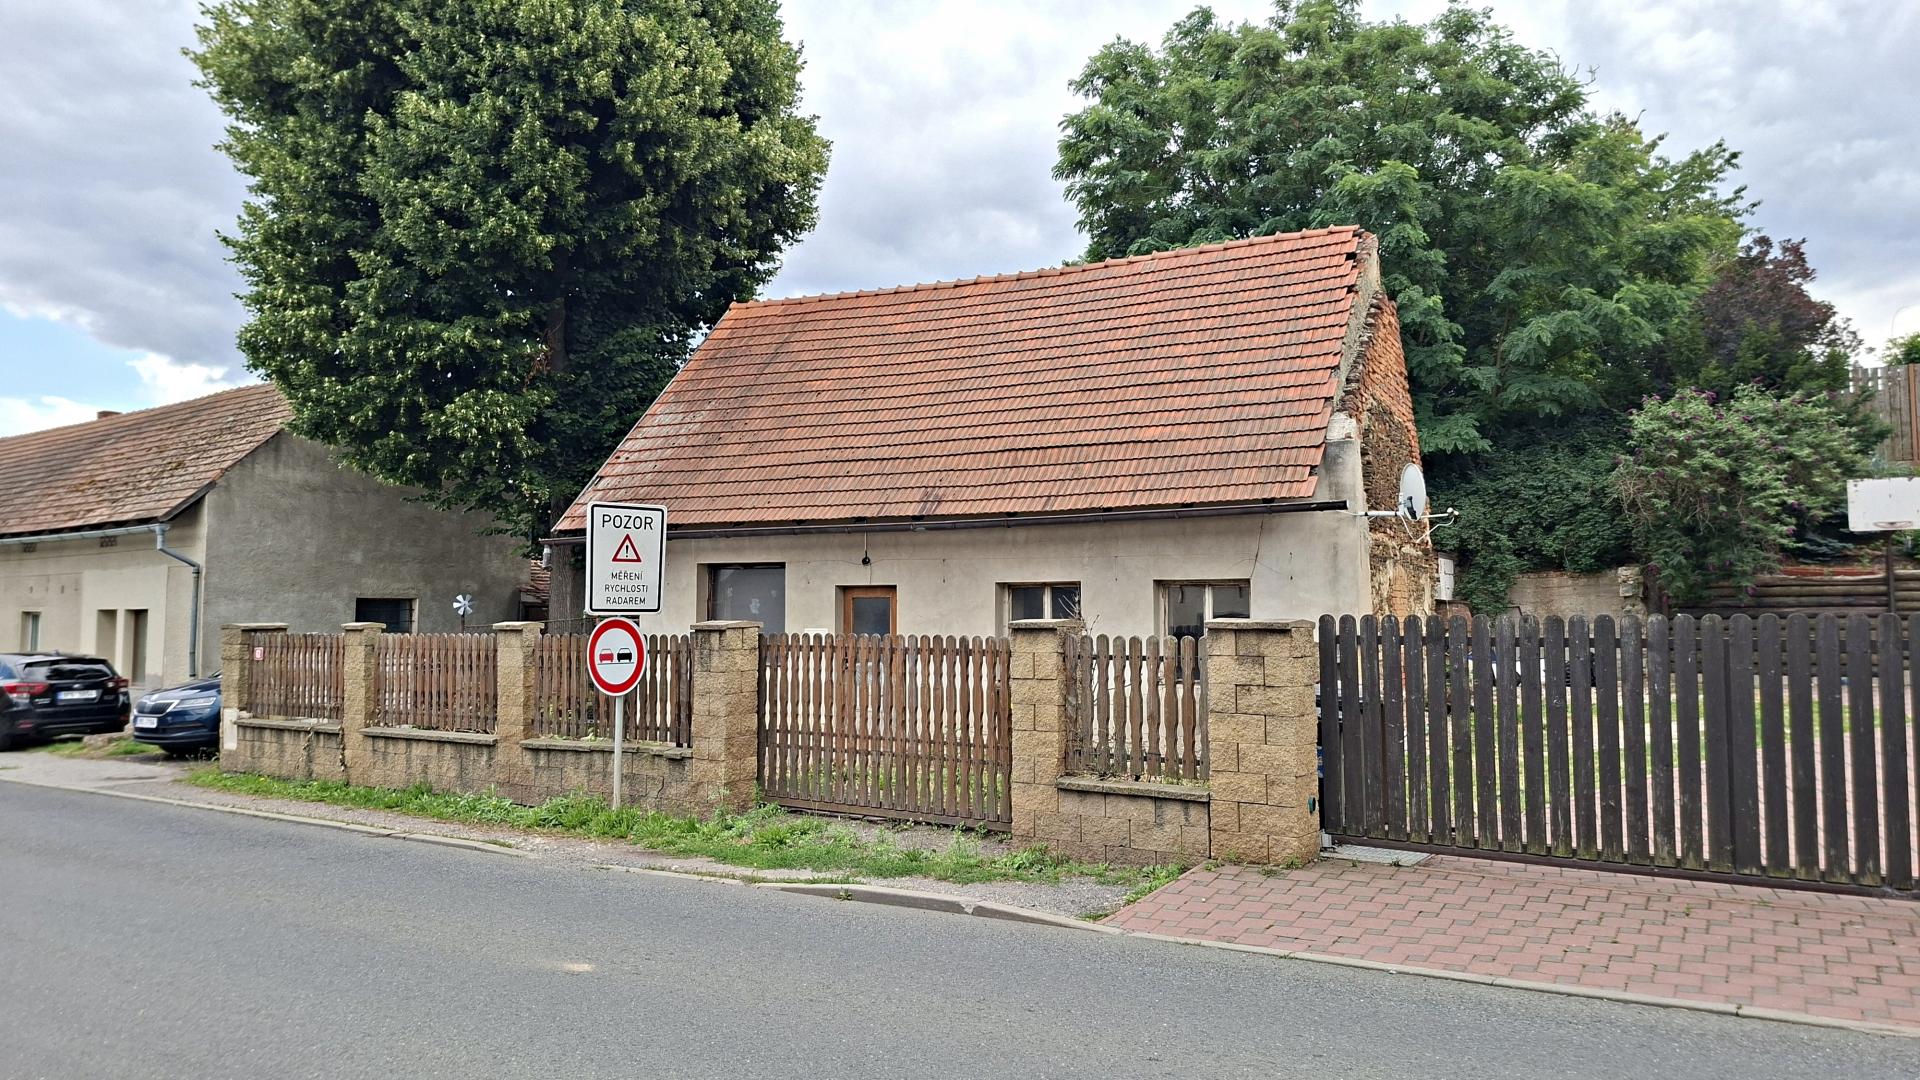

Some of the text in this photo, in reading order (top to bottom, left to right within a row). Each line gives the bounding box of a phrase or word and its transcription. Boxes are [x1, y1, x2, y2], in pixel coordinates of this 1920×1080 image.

[602, 514, 653, 530] POZOR
[611, 570, 643, 581] MĚŘENÍ
[604, 584, 648, 593] RYCHLOSTI
[606, 596, 646, 605] RADAREM
